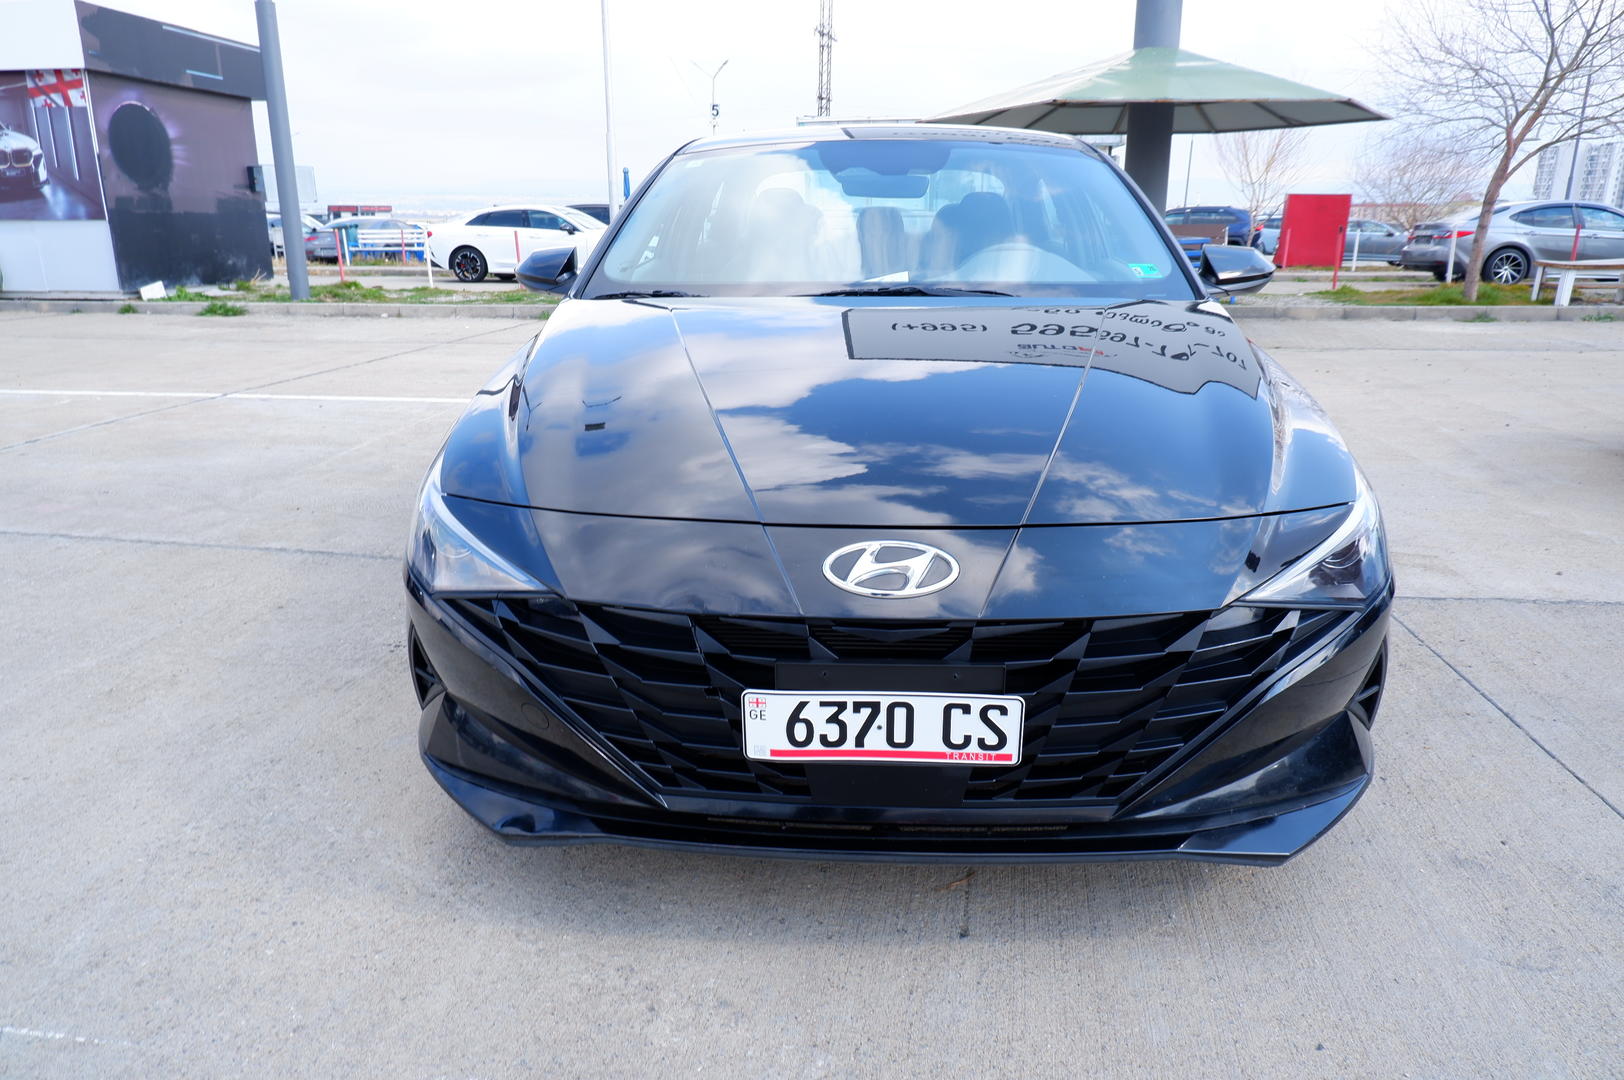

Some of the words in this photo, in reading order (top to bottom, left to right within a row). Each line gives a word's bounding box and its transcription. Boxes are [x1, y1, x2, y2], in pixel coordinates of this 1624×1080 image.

[712, 104, 719, 117] 5
[749, 709, 767, 721] GE
[785, 700, 915, 749] 6370
[942, 702, 1009, 751] CS
[945, 752, 997, 761] TRANSIT
